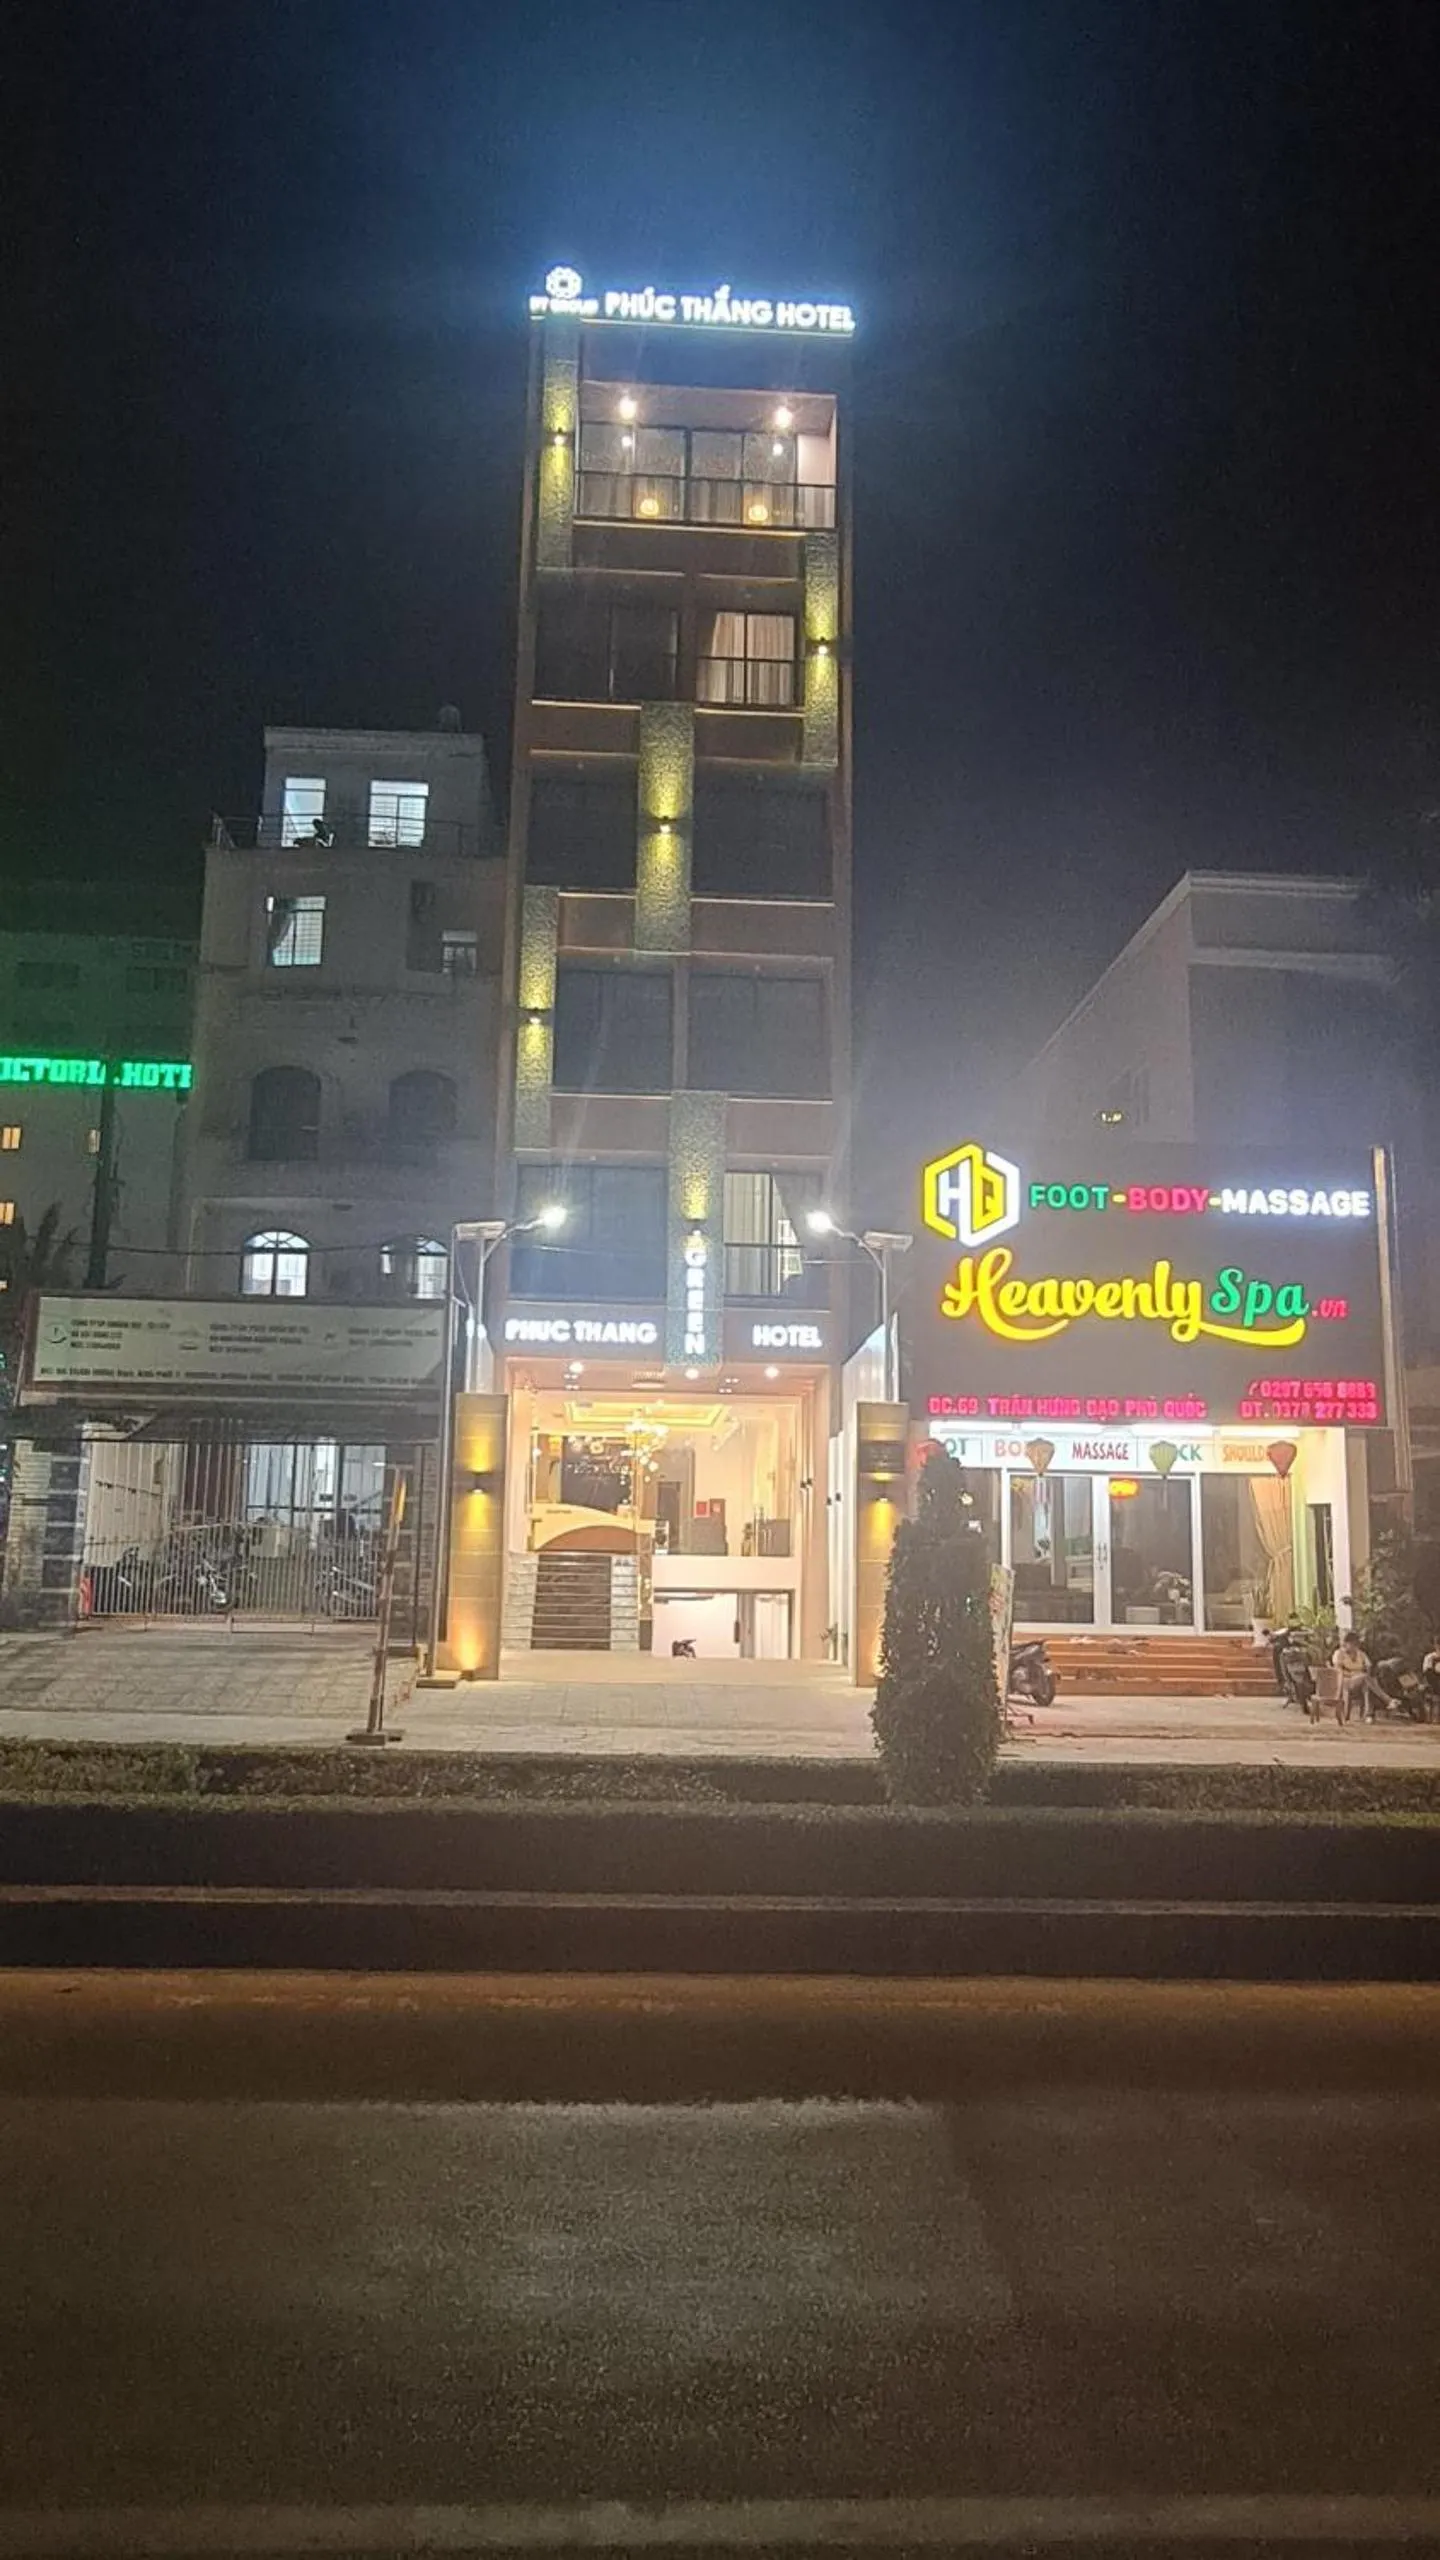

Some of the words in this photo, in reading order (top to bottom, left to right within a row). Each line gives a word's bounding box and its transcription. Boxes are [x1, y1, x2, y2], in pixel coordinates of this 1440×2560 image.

[604, 286, 677, 321] PHÚC
[776, 302, 856, 331] HOTEL
[684, 1247, 707, 1356] GREEN
[940, 1247, 1206, 1346] Heavenly
[505, 1320, 571, 1343] PHUC
[573, 1320, 658, 1345] THANG
[752, 1325, 823, 1349] HOTEL
[1072, 1442, 1129, 1461] MASSAGE
[1222, 1445, 1269, 1462] SHOULD
